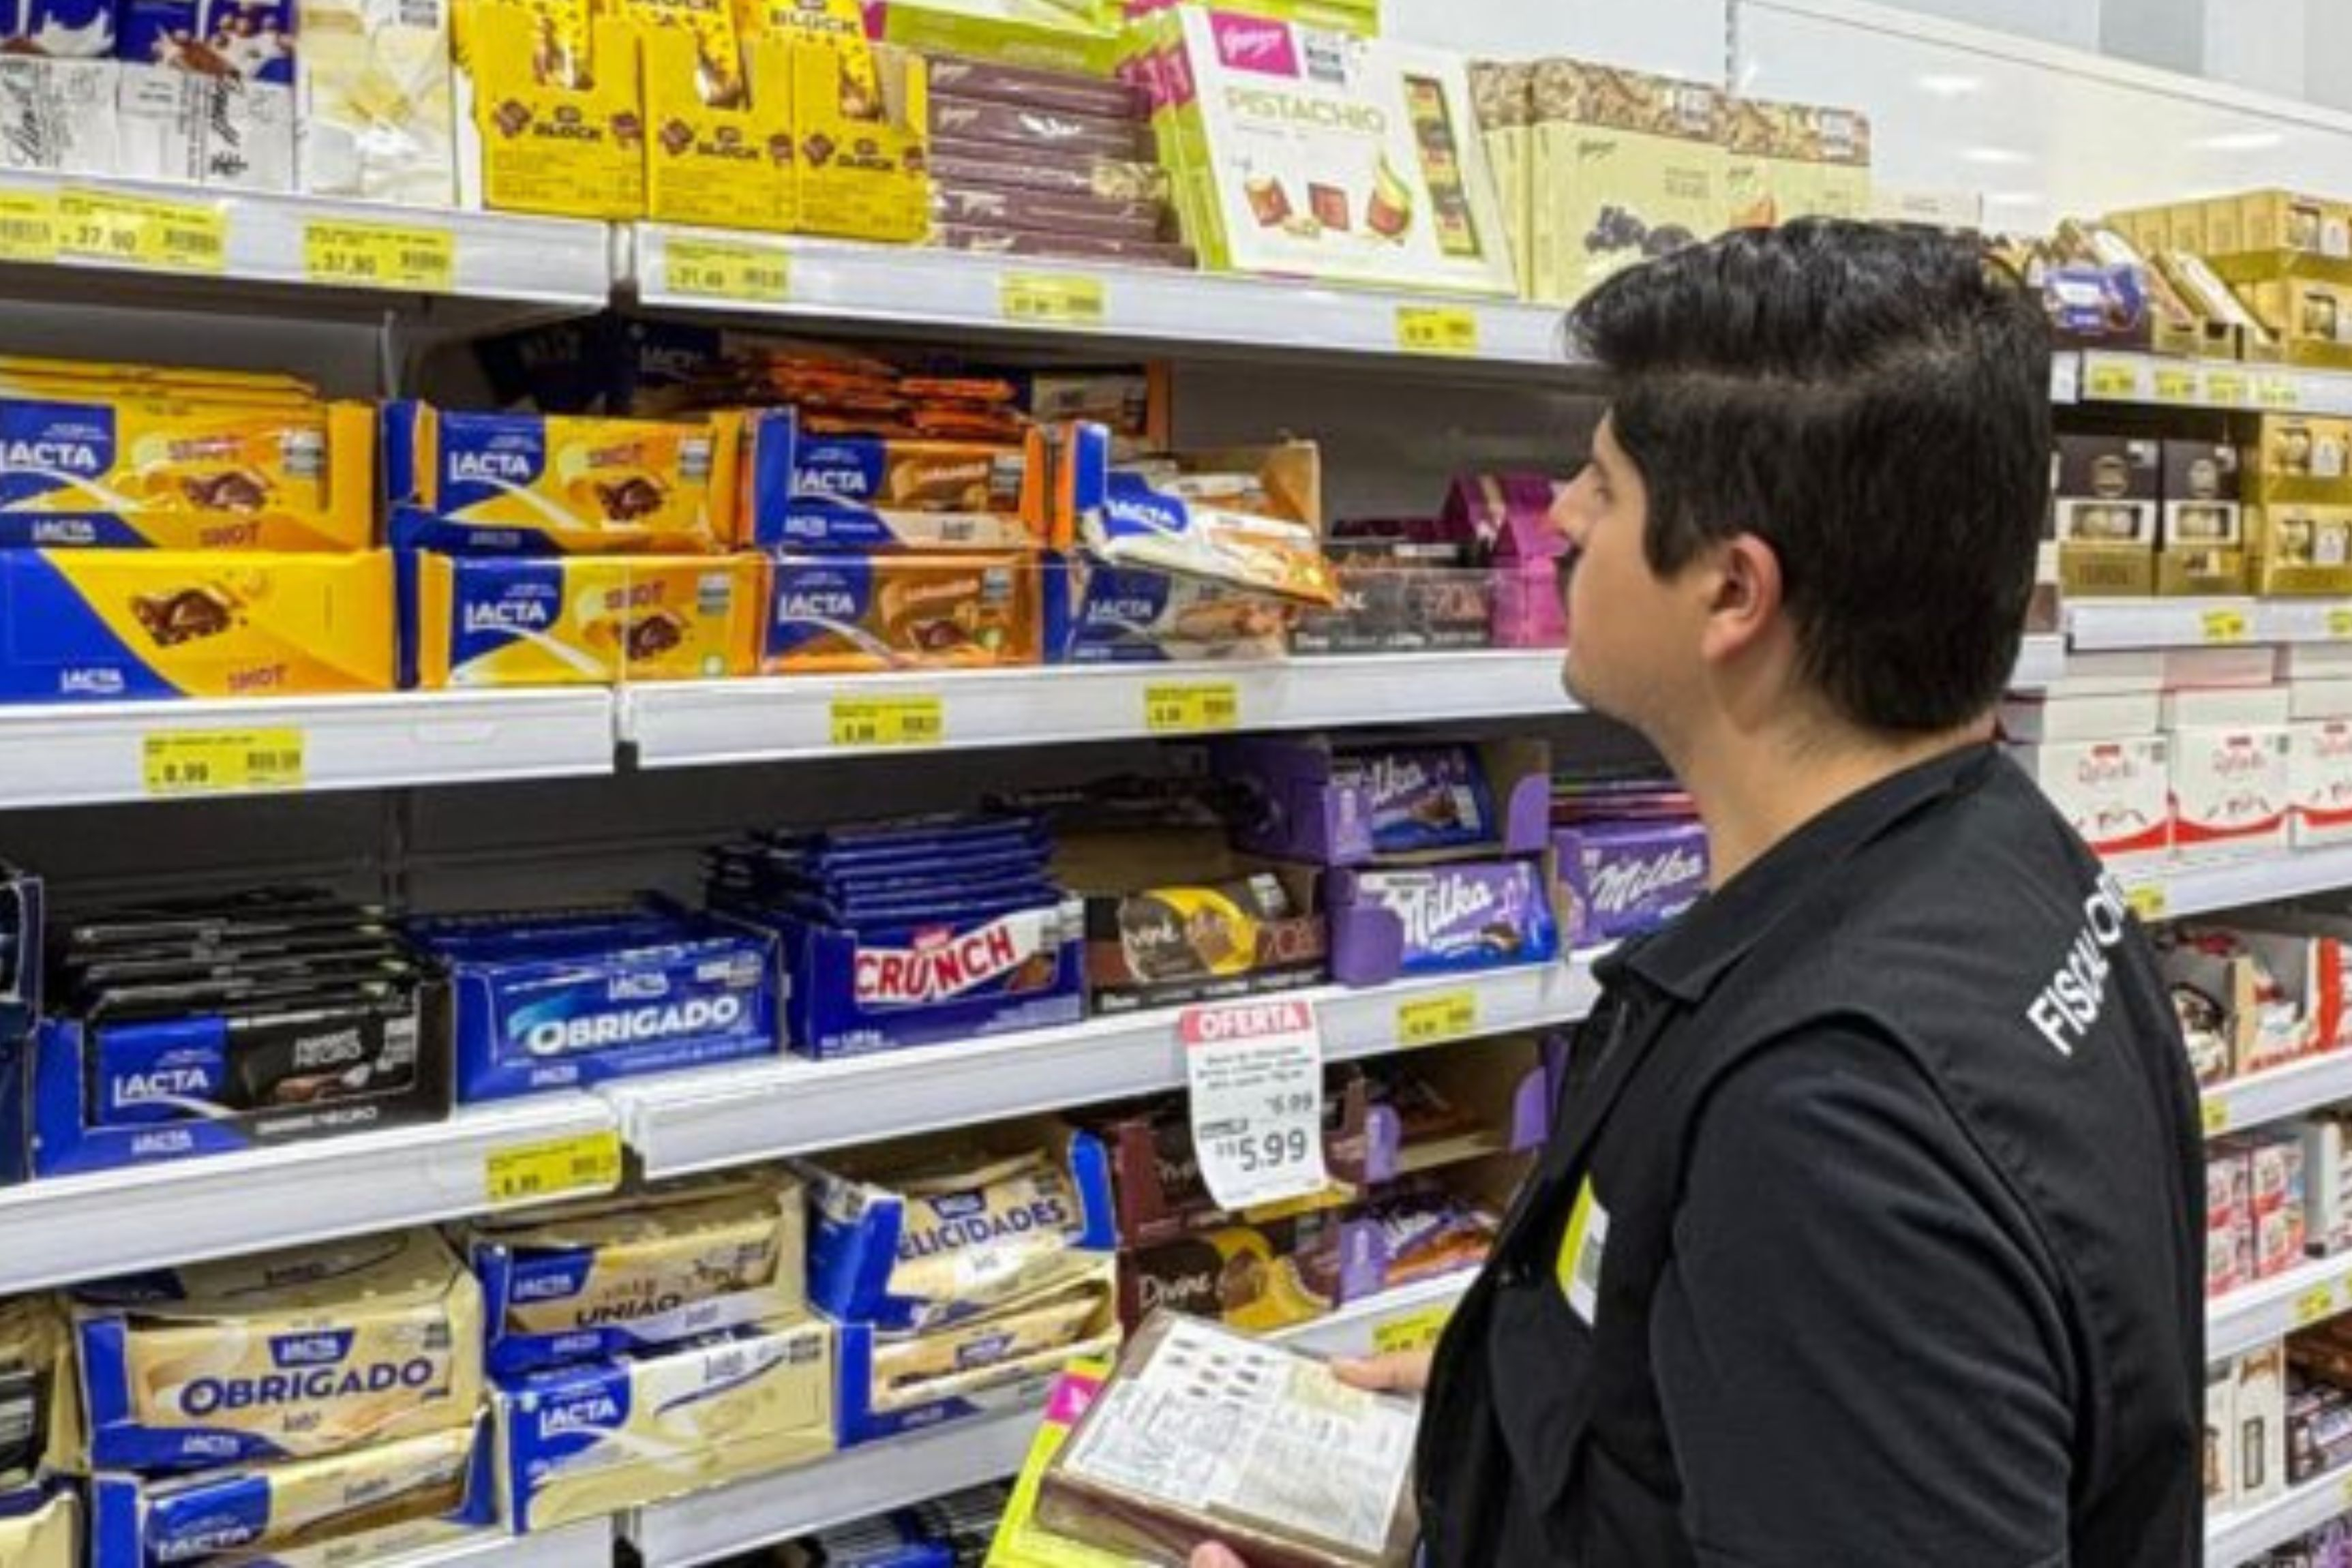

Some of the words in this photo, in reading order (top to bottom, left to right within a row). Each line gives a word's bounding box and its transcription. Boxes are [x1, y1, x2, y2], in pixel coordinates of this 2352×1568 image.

[1224, 87, 1387, 135] PISTACHIO
[450, 451, 531, 481] LACTA
[791, 470, 867, 496] LACTA
[464, 603, 547, 631] LACTA
[779, 592, 856, 619] LACTA
[1088, 598, 1154, 623] LACTA
[61, 667, 125, 694] LACTA
[1588, 844, 1702, 914] Milka
[856, 926, 1016, 996] CRUNCH
[526, 995, 741, 1056] OBRIGADO
[1198, 1002, 1301, 1040] OFERTA
[113, 1068, 209, 1107] LACTA
[130, 1130, 194, 1154] LACTA
[898, 1198, 1066, 1261] ELICIDADES
[179, 1357, 435, 1417] OBRIGADO
[540, 1398, 619, 1437] LACTA
[157, 1527, 251, 1563] LACTA
